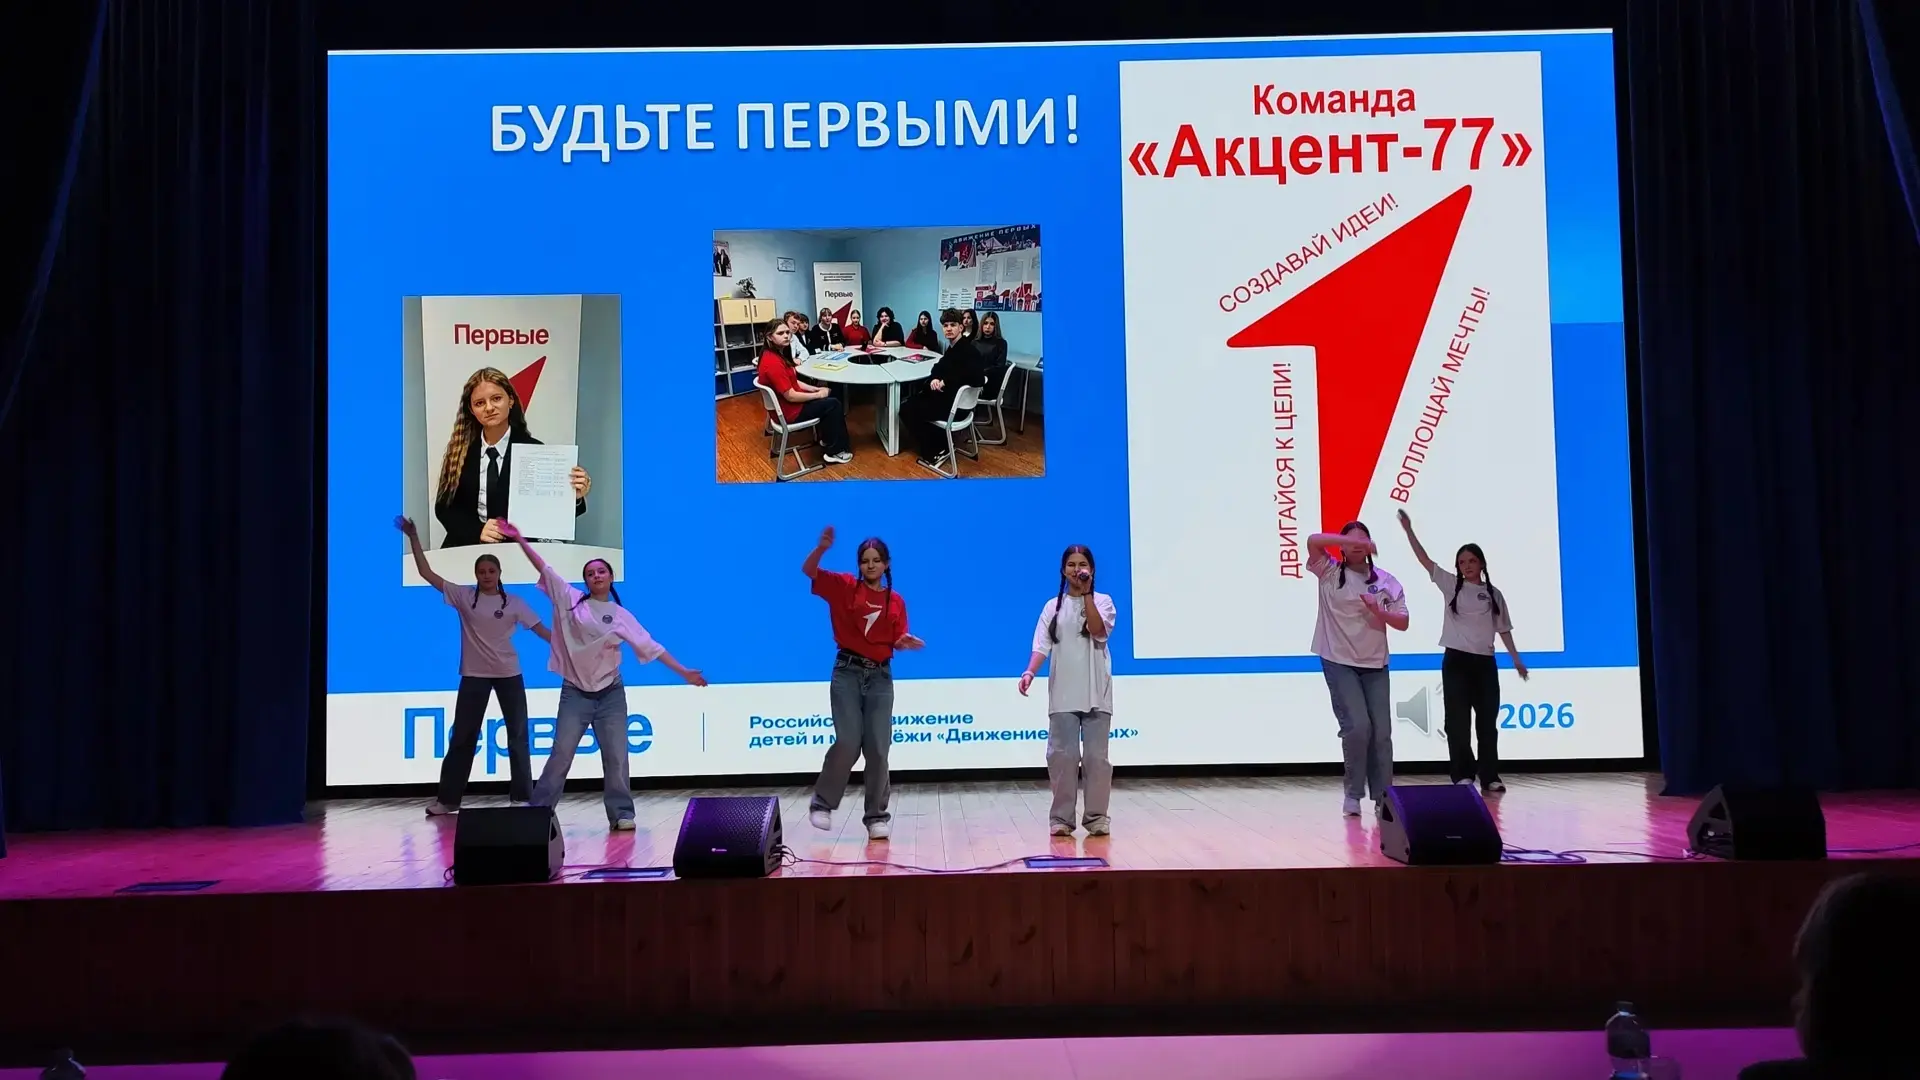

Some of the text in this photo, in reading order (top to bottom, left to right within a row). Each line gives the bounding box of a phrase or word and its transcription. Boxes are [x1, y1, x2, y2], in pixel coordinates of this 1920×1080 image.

[1253, 84, 1416, 117] Команда
[491, 94, 1079, 163] БУДЬТЕ ПЕРВЫМИ!
[1128, 117, 1533, 184] «Акцент-77»
[953, 223, 1036, 244] ДВИЖЕНИЕ ПЕРВЫХ
[1219, 193, 1399, 313] СОЗДАВАЙ ИДЕИ!
[824, 290, 854, 299] Первые
[454, 324, 549, 351] Первые
[1390, 287, 1491, 504] ВОПЛОЩАЙ МЕЧТЫ!
[1272, 362, 1303, 579] ДВИГАЙСЯ К ЦЕЛИ!
[749, 714, 974, 729] Российс вижение
[1499, 702, 1575, 729] 2026
[749, 732, 808, 748] детей
[812, 734, 824, 744] и
[936, 727, 1048, 744] «Движение
